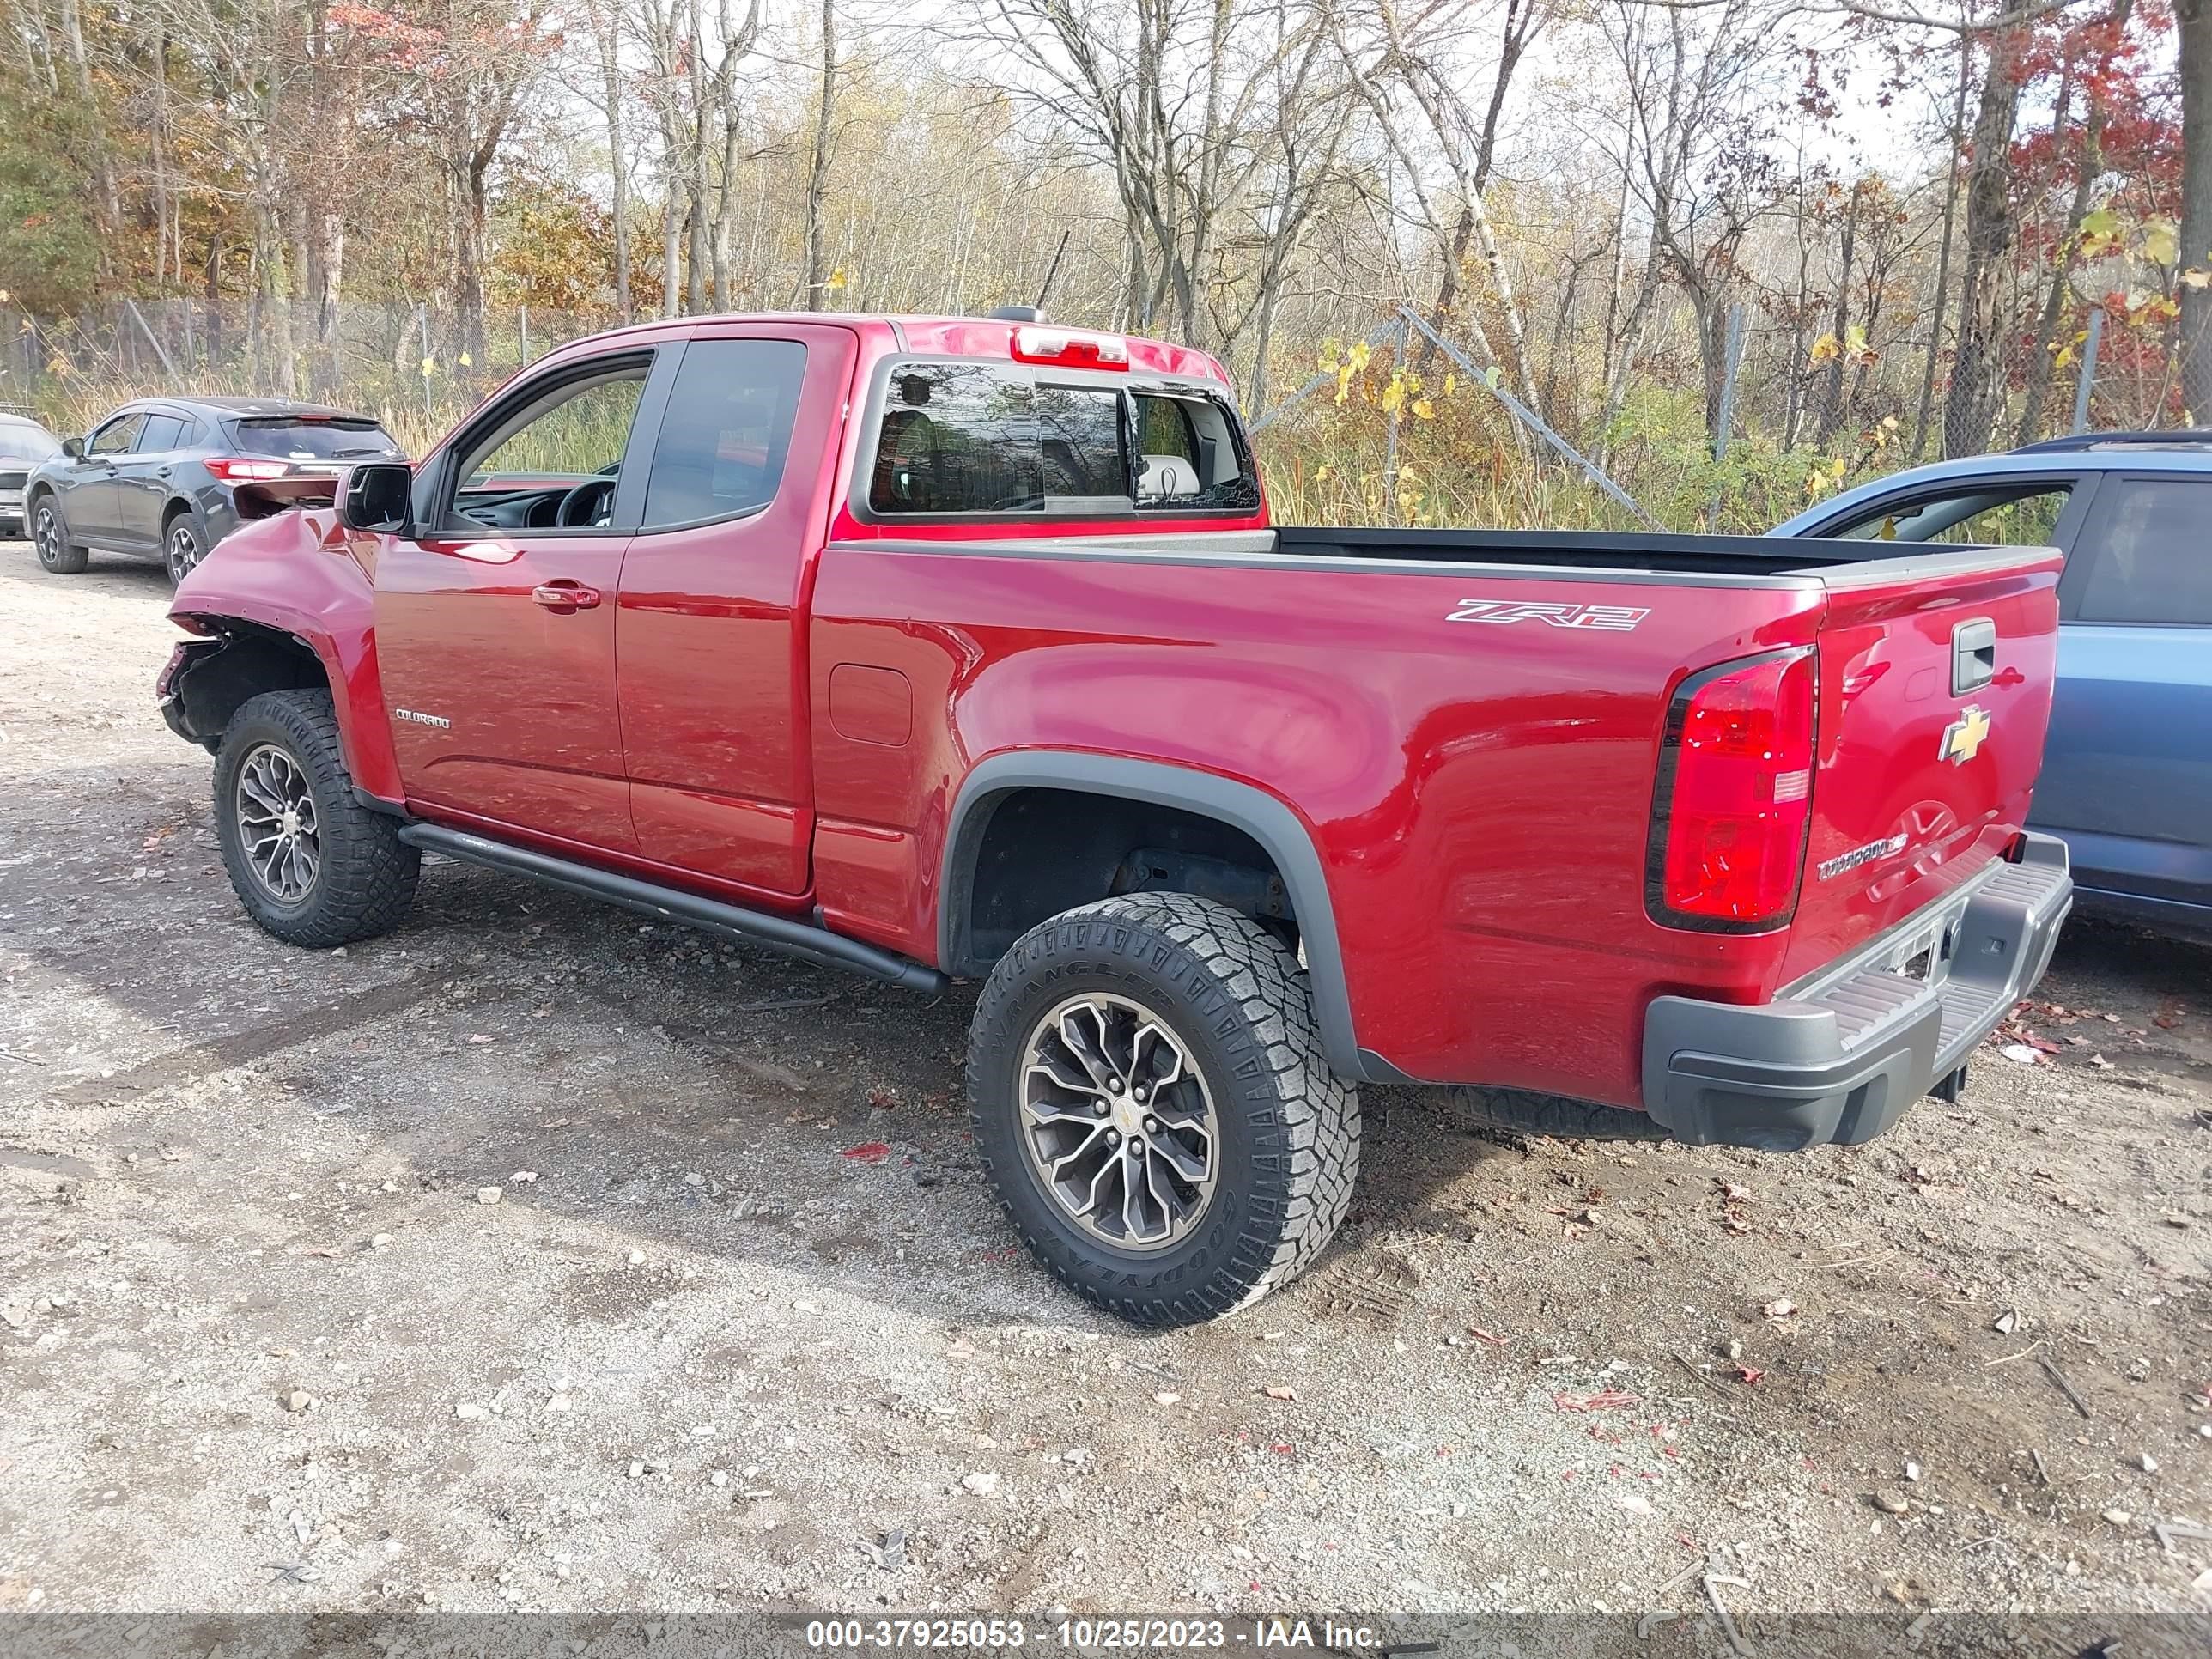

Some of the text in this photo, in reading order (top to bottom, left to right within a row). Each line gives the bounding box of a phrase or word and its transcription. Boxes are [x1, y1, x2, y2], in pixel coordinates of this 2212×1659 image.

[1444, 598, 1652, 631] ZR2
[396, 708, 451, 728] COLORADO
[989, 960, 1176, 1057] WRANGLER
